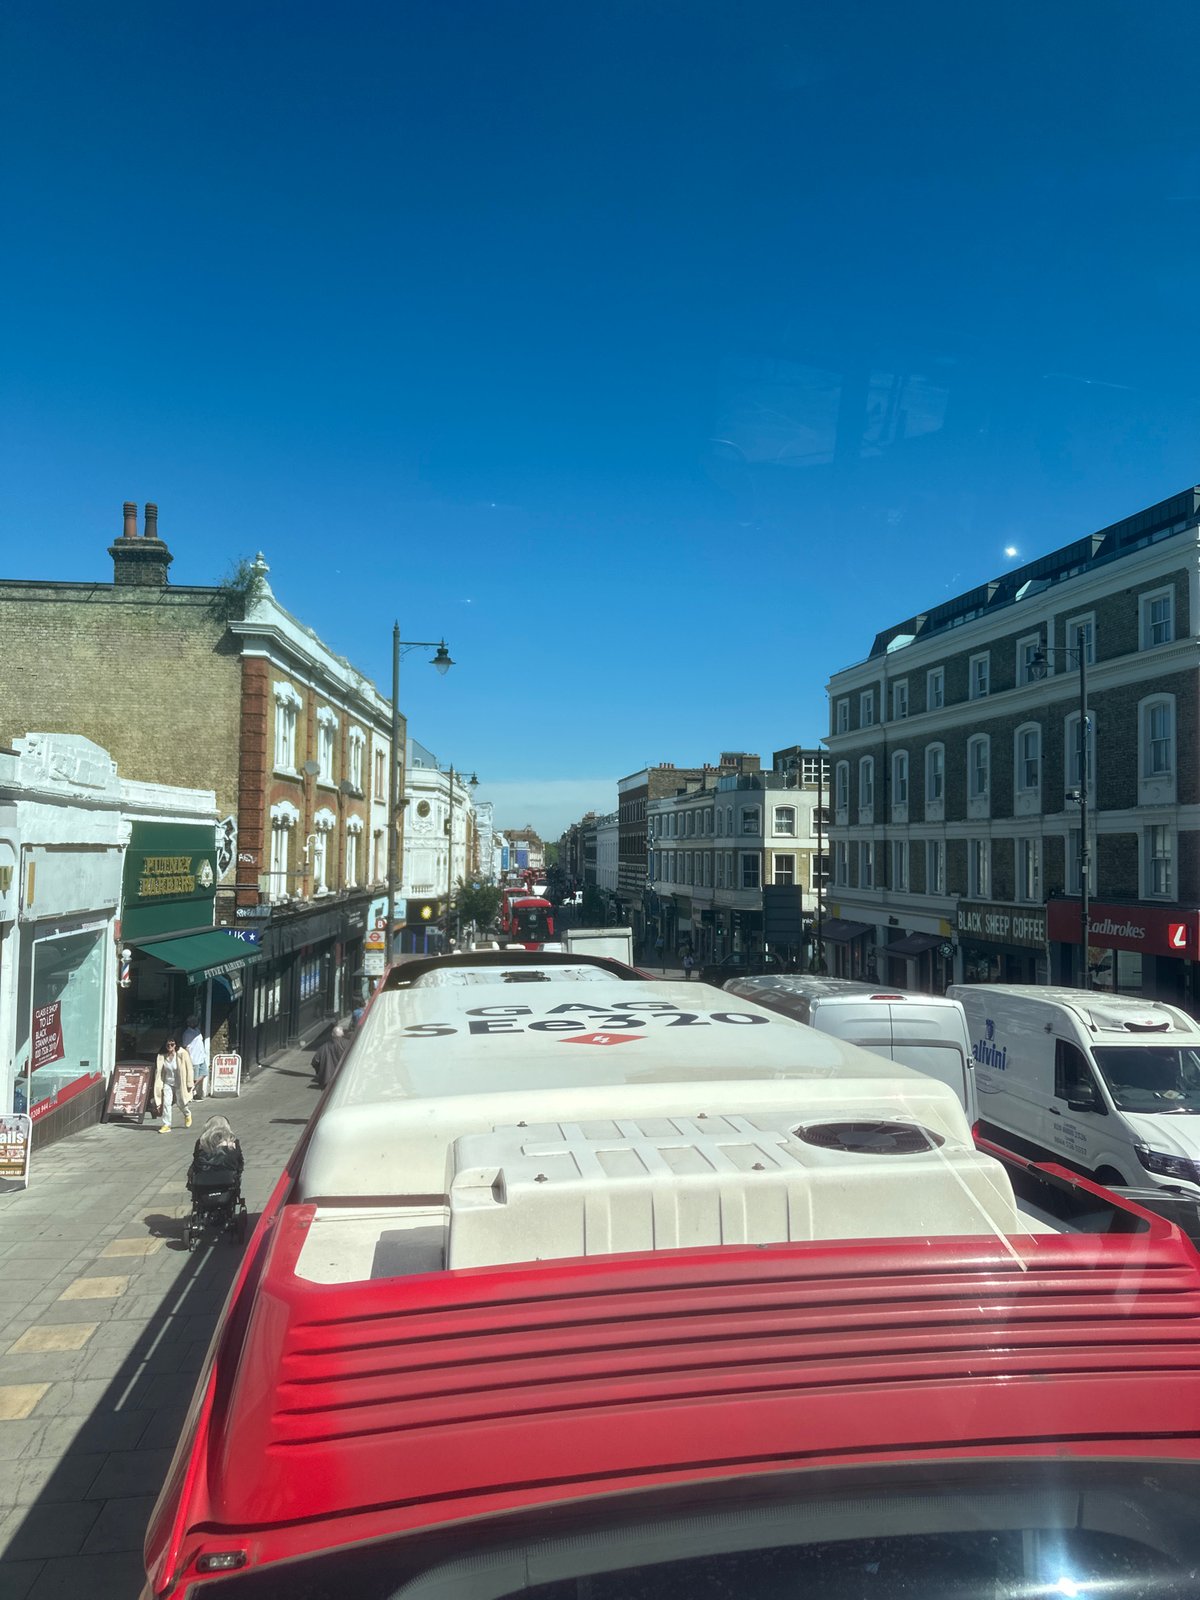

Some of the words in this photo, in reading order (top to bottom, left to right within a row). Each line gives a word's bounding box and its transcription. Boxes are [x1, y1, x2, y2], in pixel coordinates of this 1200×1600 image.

[958, 911, 982, 932] BLACK
[985, 914, 1010, 936] SHEEP
[1012, 917, 1045, 942] COFFEE
[204, 966, 225, 979] PUTNEY
[49, 1003, 59, 1014] SHOP
[40, 1017, 47, 1028] TO
[46, 1013, 54, 1026] LET
[35, 1028, 47, 1040] BLACK
[972, 1039, 1007, 1071] alivini
